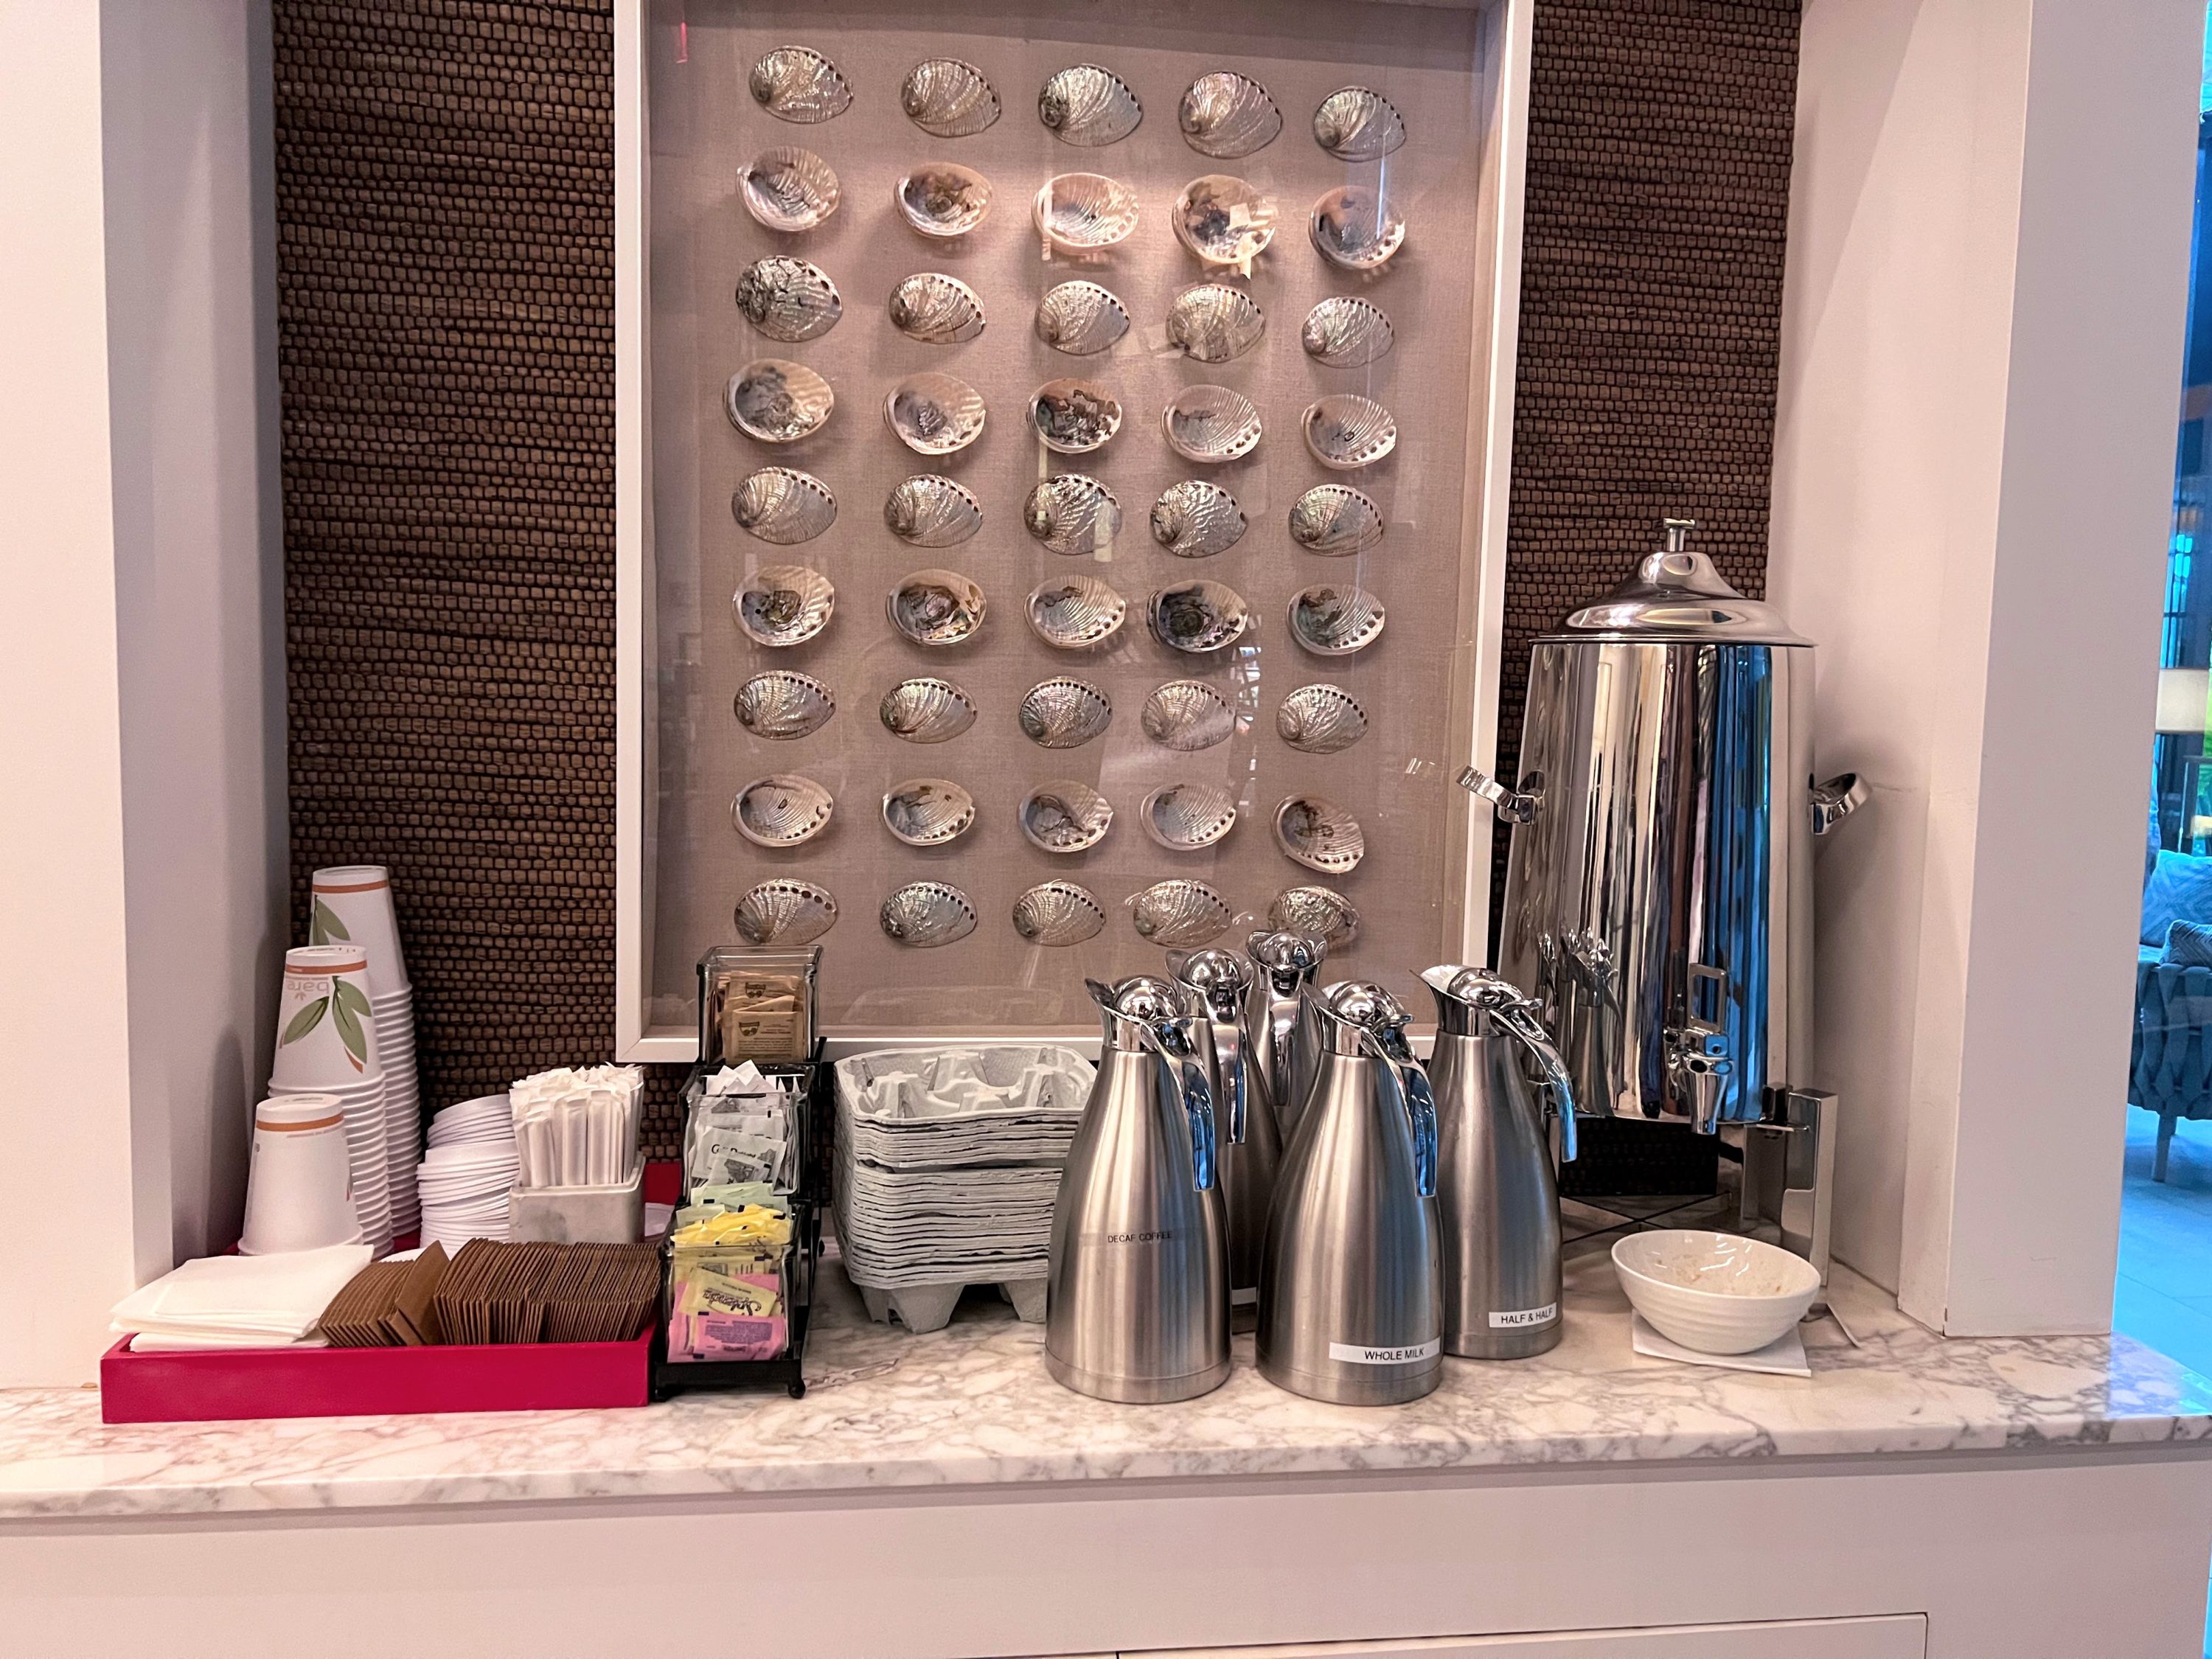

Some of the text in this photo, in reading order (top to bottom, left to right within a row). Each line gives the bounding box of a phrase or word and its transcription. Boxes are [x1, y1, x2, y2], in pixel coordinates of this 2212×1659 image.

[287, 981, 330, 995] bare
[1107, 1231, 1173, 1243] DECAF COFFEE
[1500, 1308, 1553, 1324] HALF & HALF
[1364, 1347, 1425, 1360] WHOLE MILK
